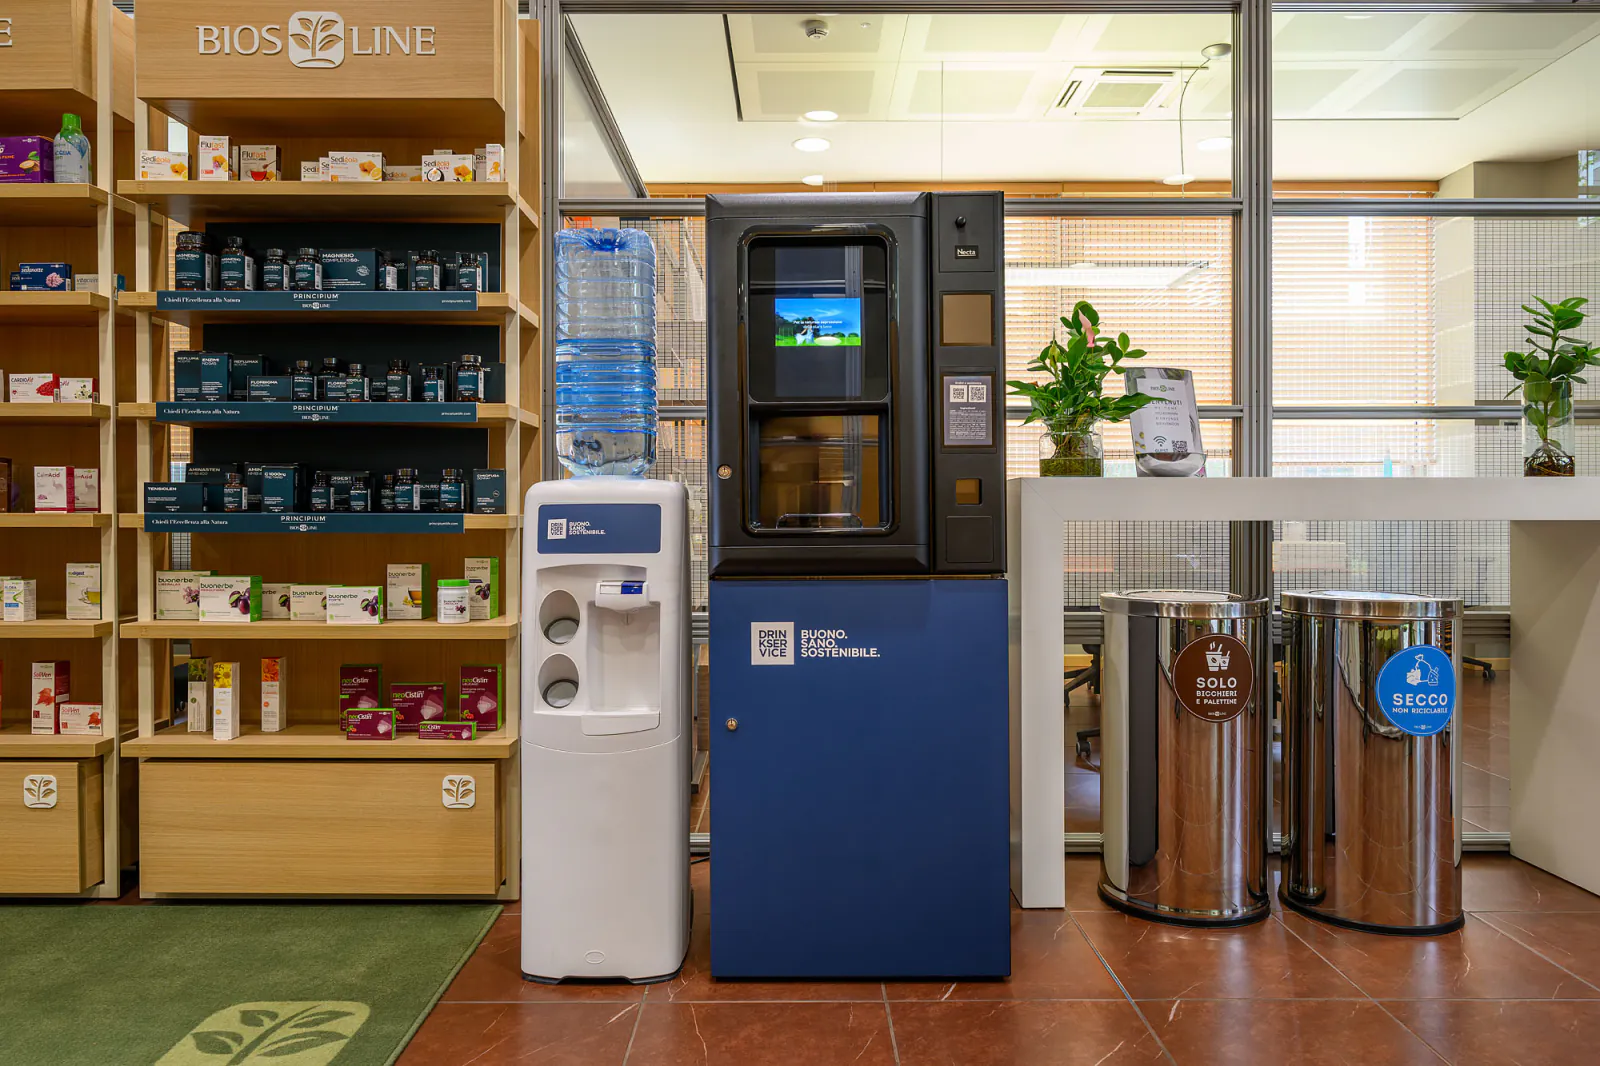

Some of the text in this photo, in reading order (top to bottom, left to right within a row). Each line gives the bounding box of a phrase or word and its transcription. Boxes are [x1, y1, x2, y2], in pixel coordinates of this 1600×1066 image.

[195, 25, 437, 56] BIOS LINE
[201, 141, 225, 149] Flufast
[957, 248, 976, 256] Necta
[758, 630, 787, 639] DRIN
[800, 629, 848, 639] BUONO.
[758, 639, 788, 648] KSER
[800, 638, 838, 648] SANO.
[758, 648, 787, 658] VICE
[800, 648, 881, 658] SOSTENIBILE.
[1196, 677, 1237, 689] SOLO
[1392, 693, 1448, 706] SECCO
